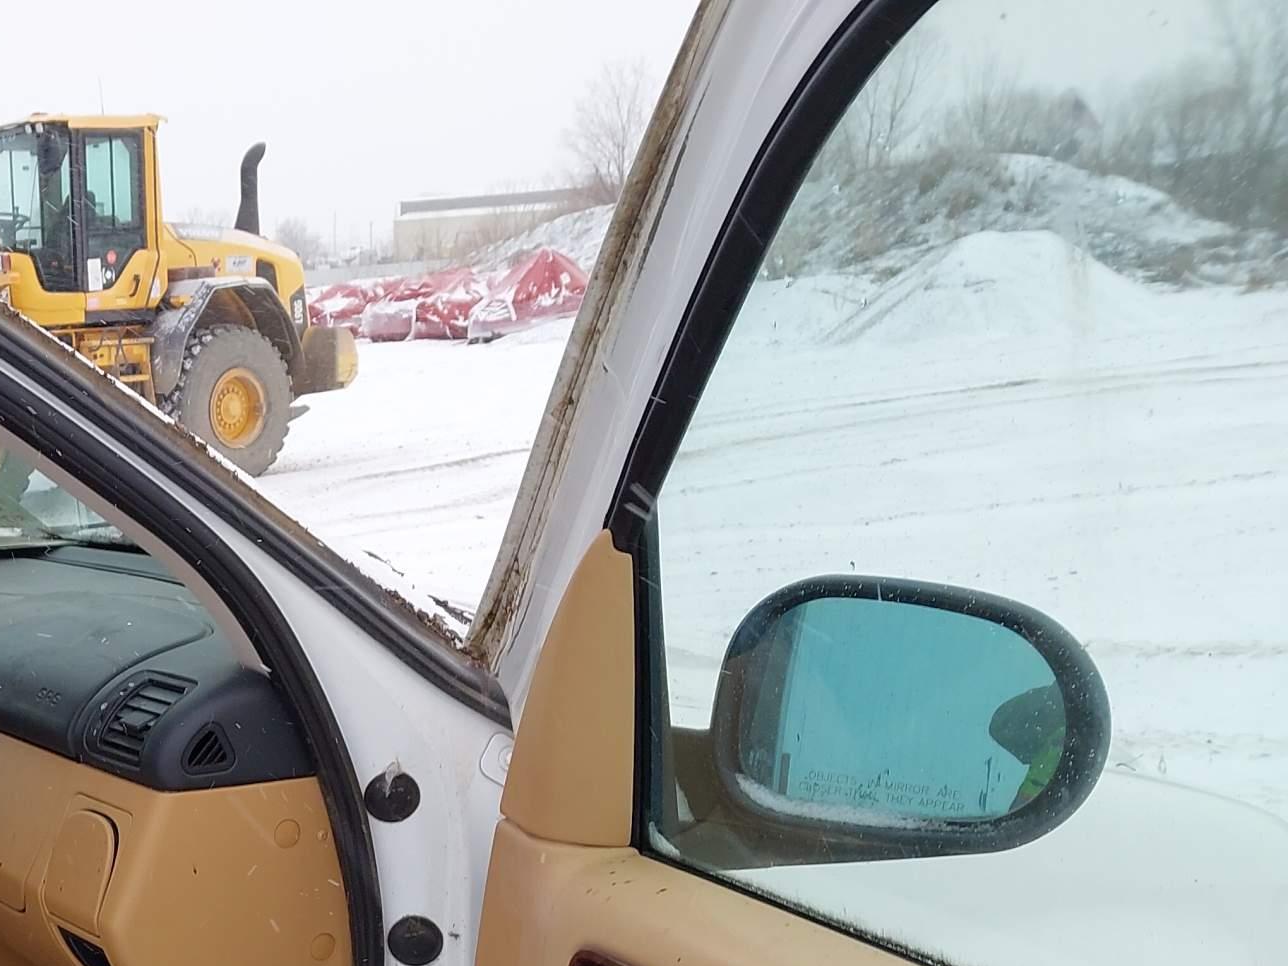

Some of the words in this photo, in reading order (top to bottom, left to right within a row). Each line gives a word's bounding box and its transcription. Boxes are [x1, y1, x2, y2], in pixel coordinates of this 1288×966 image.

[808, 770, 857, 786] OBJECTS
[884, 780, 930, 796] MIRROR
[936, 785, 961, 800] ARE
[918, 797, 966, 814] APPEAR
